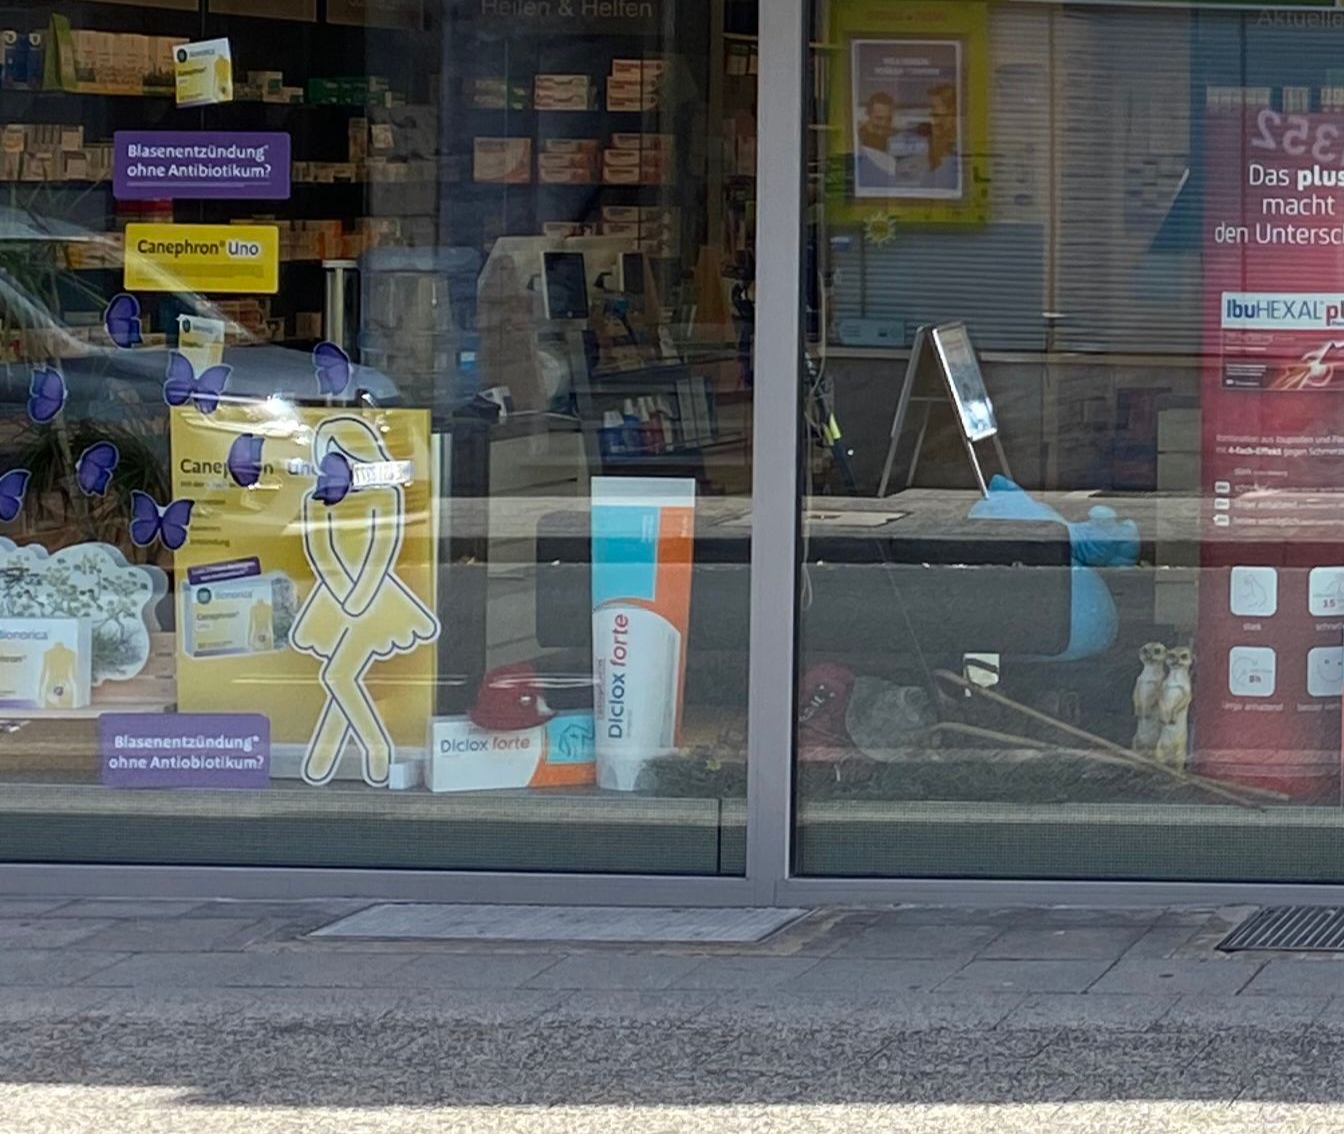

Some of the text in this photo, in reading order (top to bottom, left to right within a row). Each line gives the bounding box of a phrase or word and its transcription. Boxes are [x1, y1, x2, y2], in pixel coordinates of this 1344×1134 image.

[127, 163, 272, 178] ohne Antibiotikum?
[1249, 163, 1290, 187] Das
[1262, 193, 1336, 216] macht
[1214, 221, 1248, 244] den
[228, 241, 260, 256] Uno
[610, 613, 630, 667] forte
[607, 672, 627, 739] Diclox
[440, 736, 531, 754] Diclox forte
[109, 755, 148, 770] ohne
